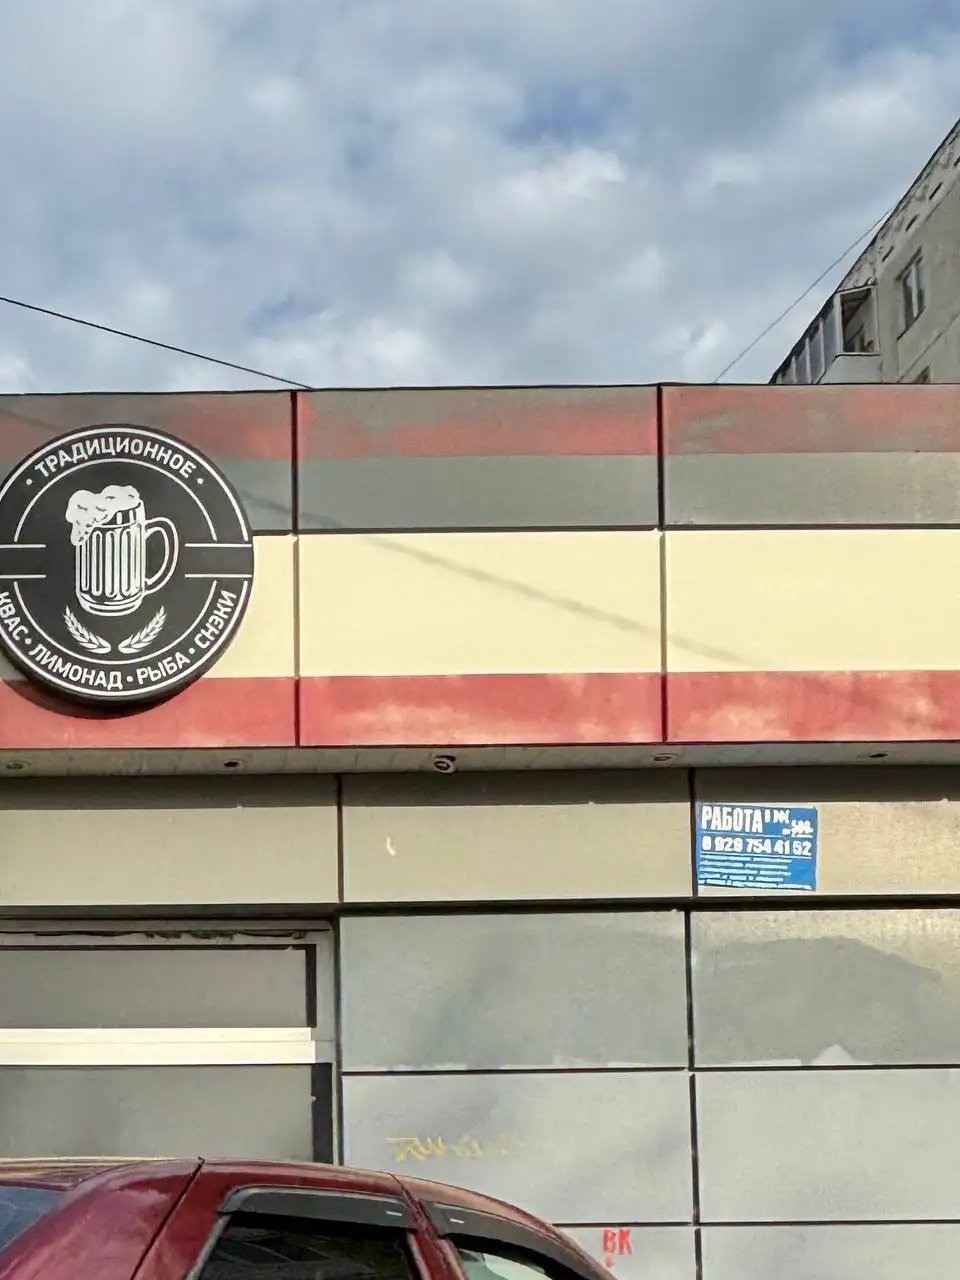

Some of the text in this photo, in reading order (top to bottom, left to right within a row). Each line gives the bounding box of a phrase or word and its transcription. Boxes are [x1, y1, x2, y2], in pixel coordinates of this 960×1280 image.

[34, 436, 198, 479] ТРАДИЦИОННОЕ
[27, 643, 124, 691] ЛИМОНАД
[135, 650, 191, 686] РЫБА
[193, 590, 238, 650] СНЭКИ
[701, 805, 764, 833] РАБОТА
[792, 840, 812, 856] 52
